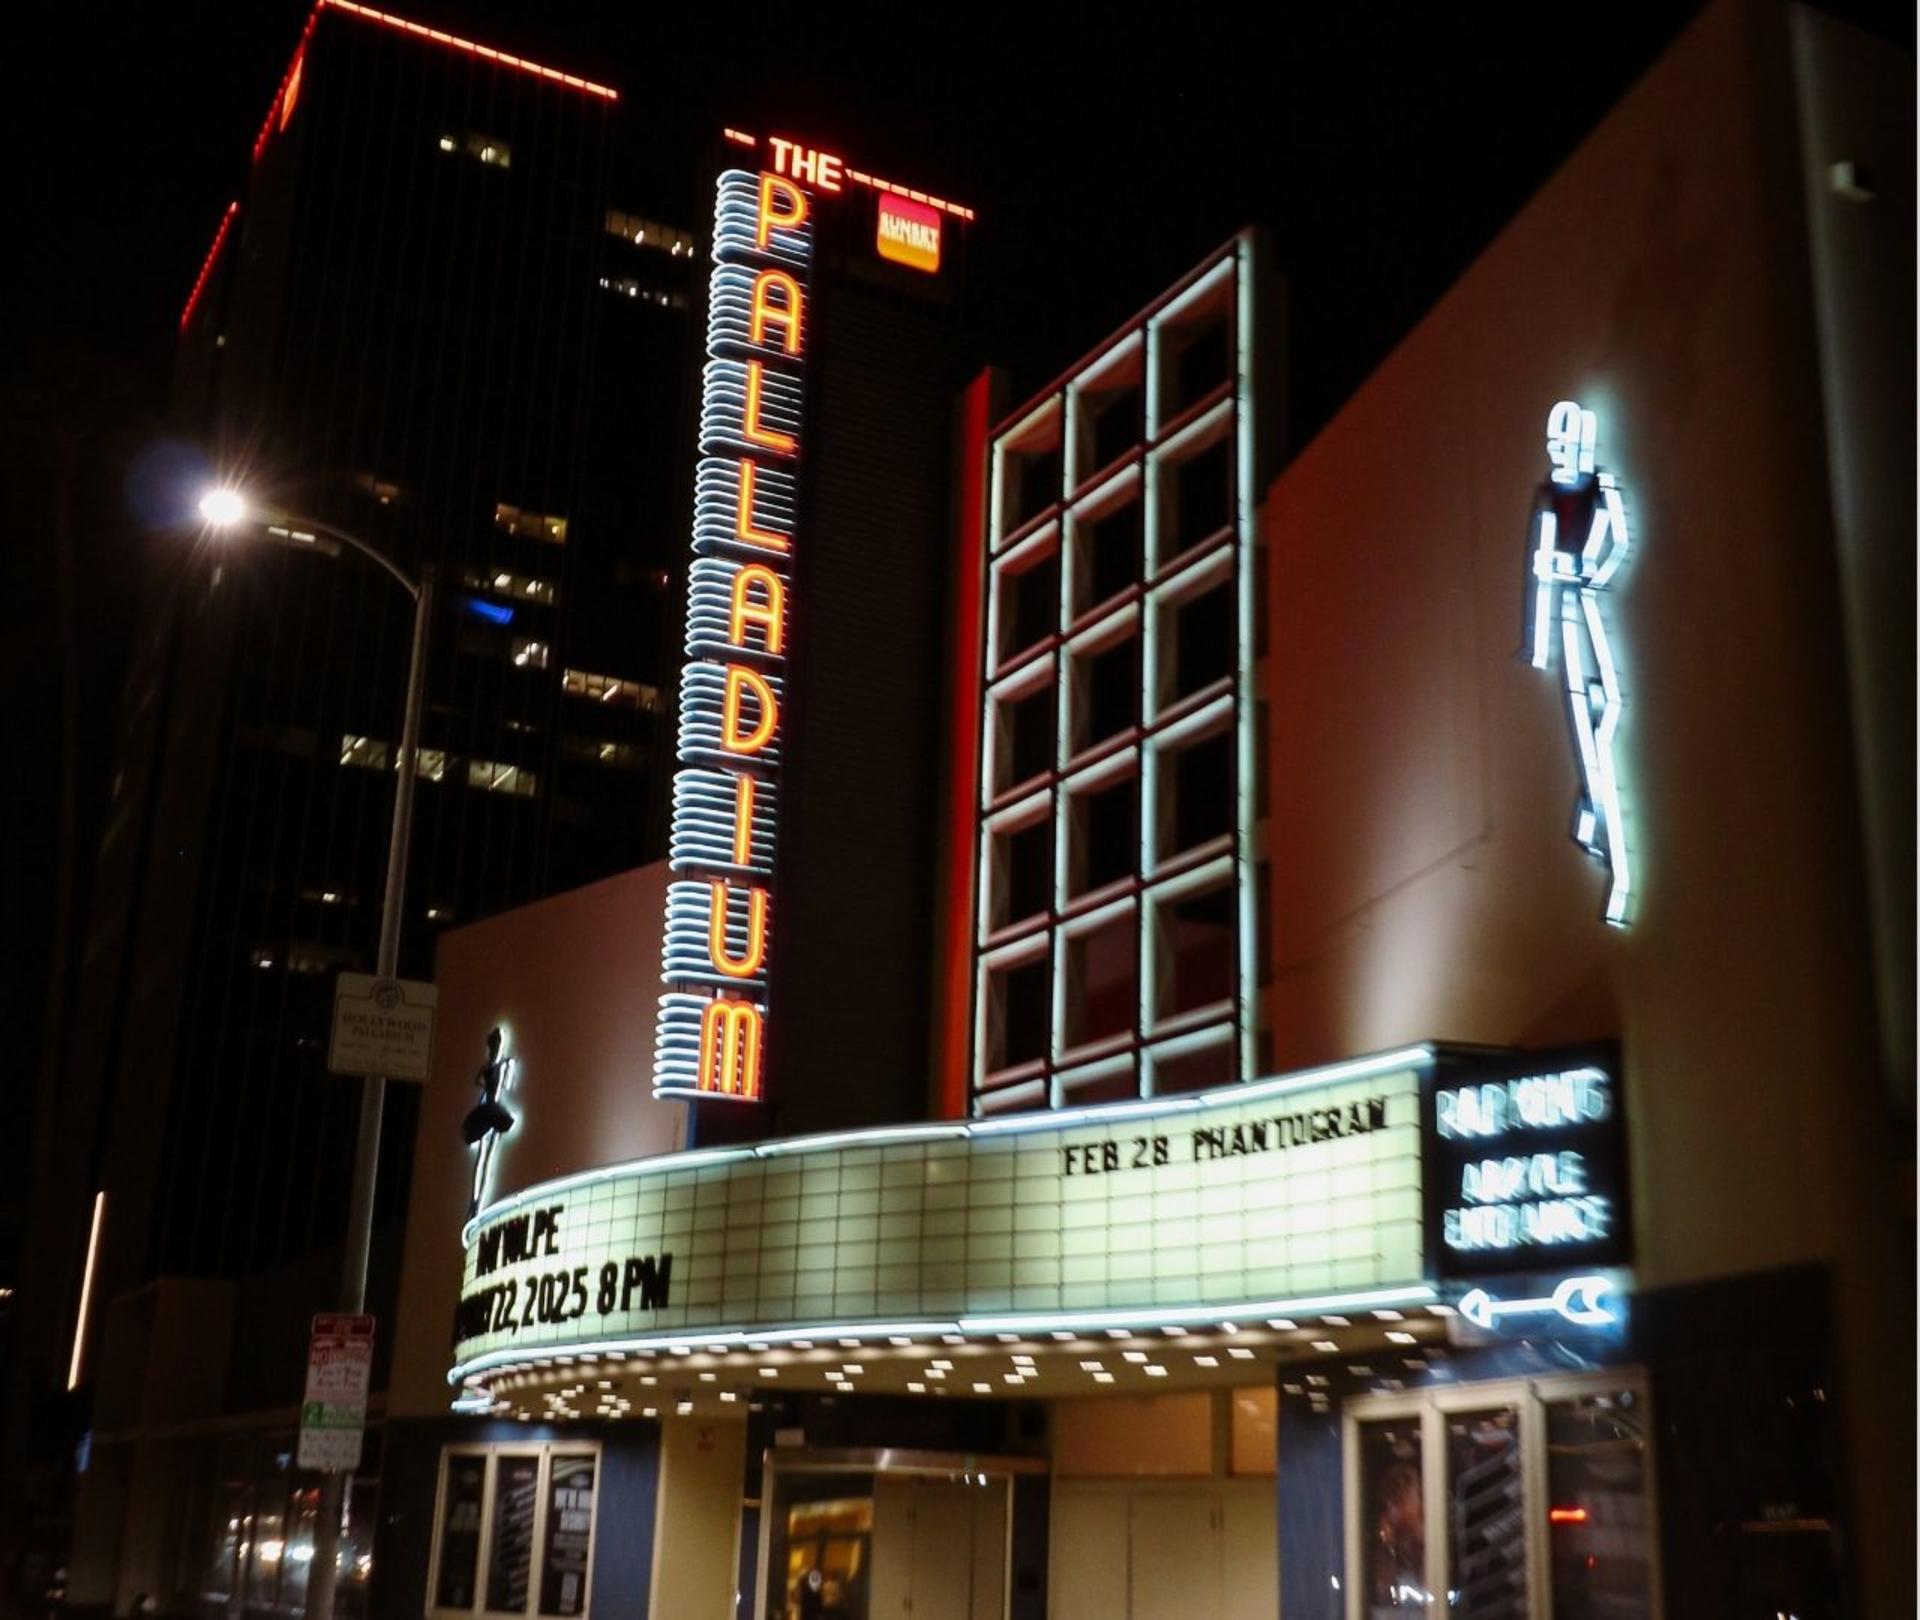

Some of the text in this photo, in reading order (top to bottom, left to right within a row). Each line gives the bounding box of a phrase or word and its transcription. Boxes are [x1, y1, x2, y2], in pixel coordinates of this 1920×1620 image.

[769, 136, 841, 192] THE
[698, 171, 807, 1098] PALLADIUM
[1065, 1140, 1120, 1176] FEB
[1132, 1136, 1169, 1168] 28
[521, 1266, 588, 1327] 2025
